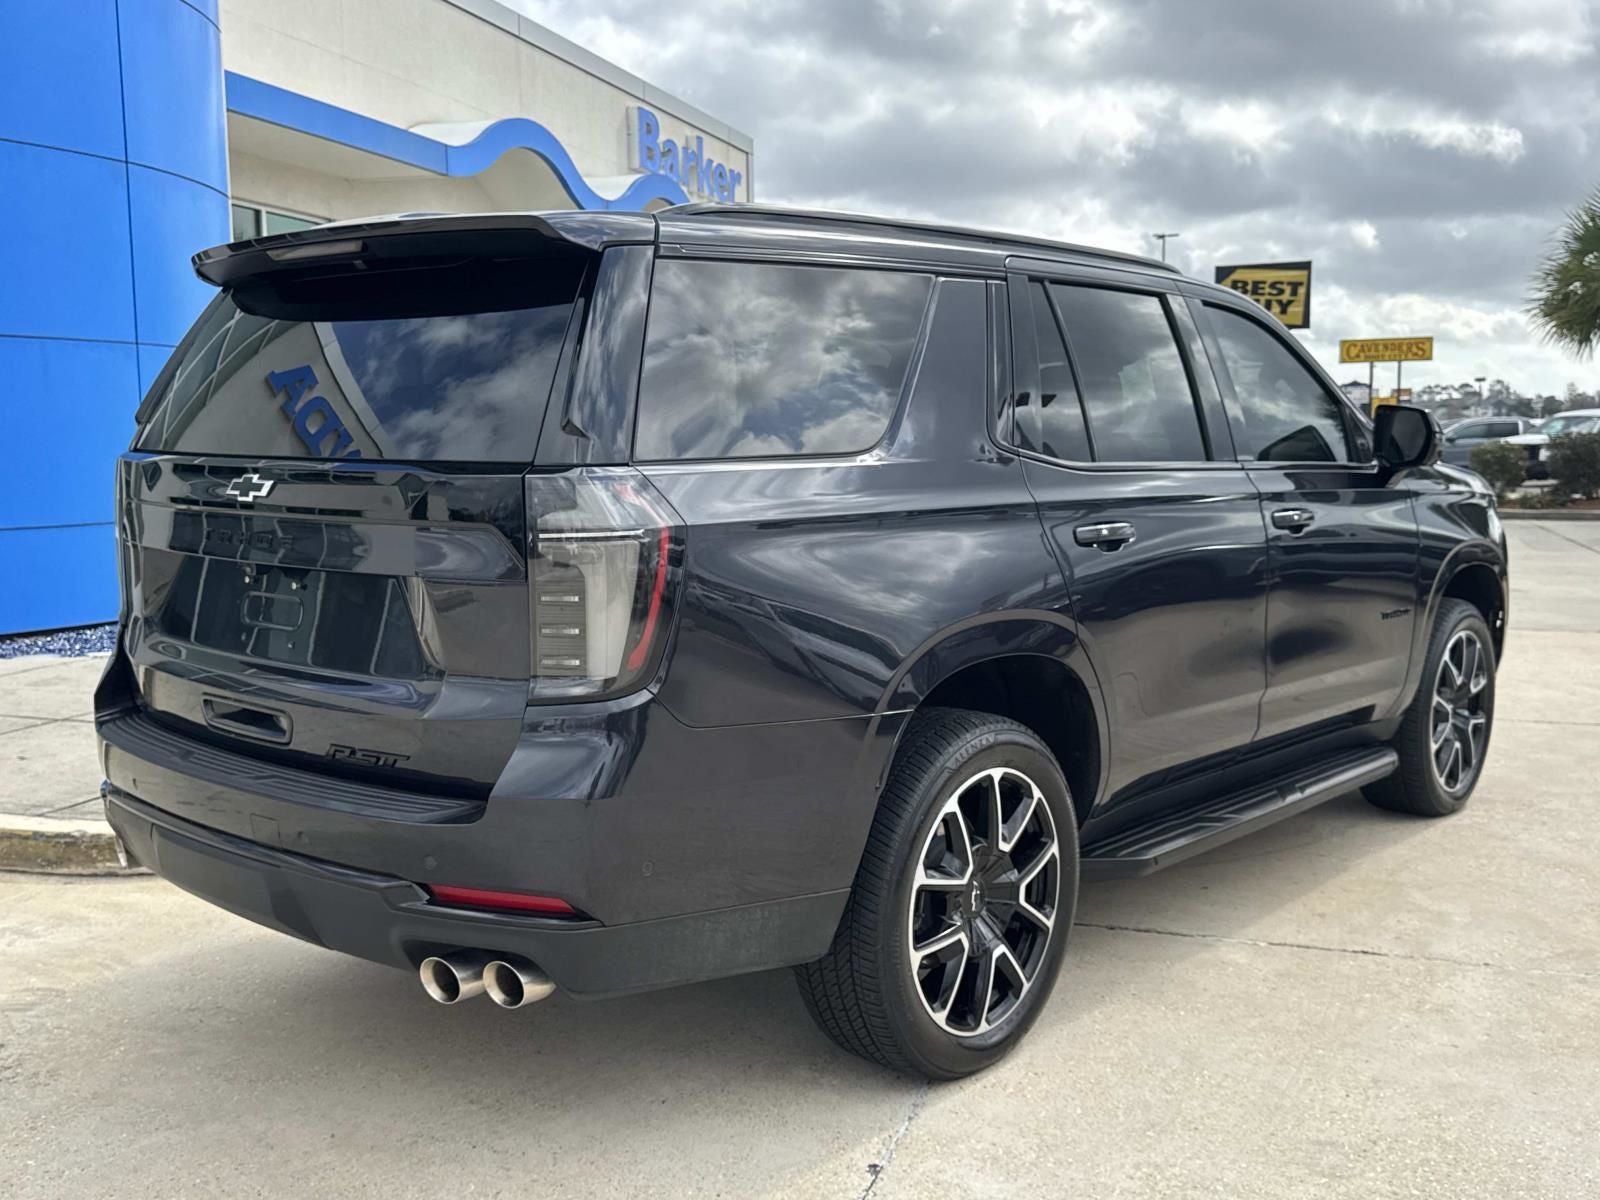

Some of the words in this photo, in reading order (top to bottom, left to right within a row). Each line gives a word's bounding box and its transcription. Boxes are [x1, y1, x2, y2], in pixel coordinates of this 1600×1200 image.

[637, 106, 742, 203] Barker
[1231, 280, 1304, 297] BEST
[1346, 341, 1426, 360] CAVENDER'S
[325, 743, 411, 768] RST
